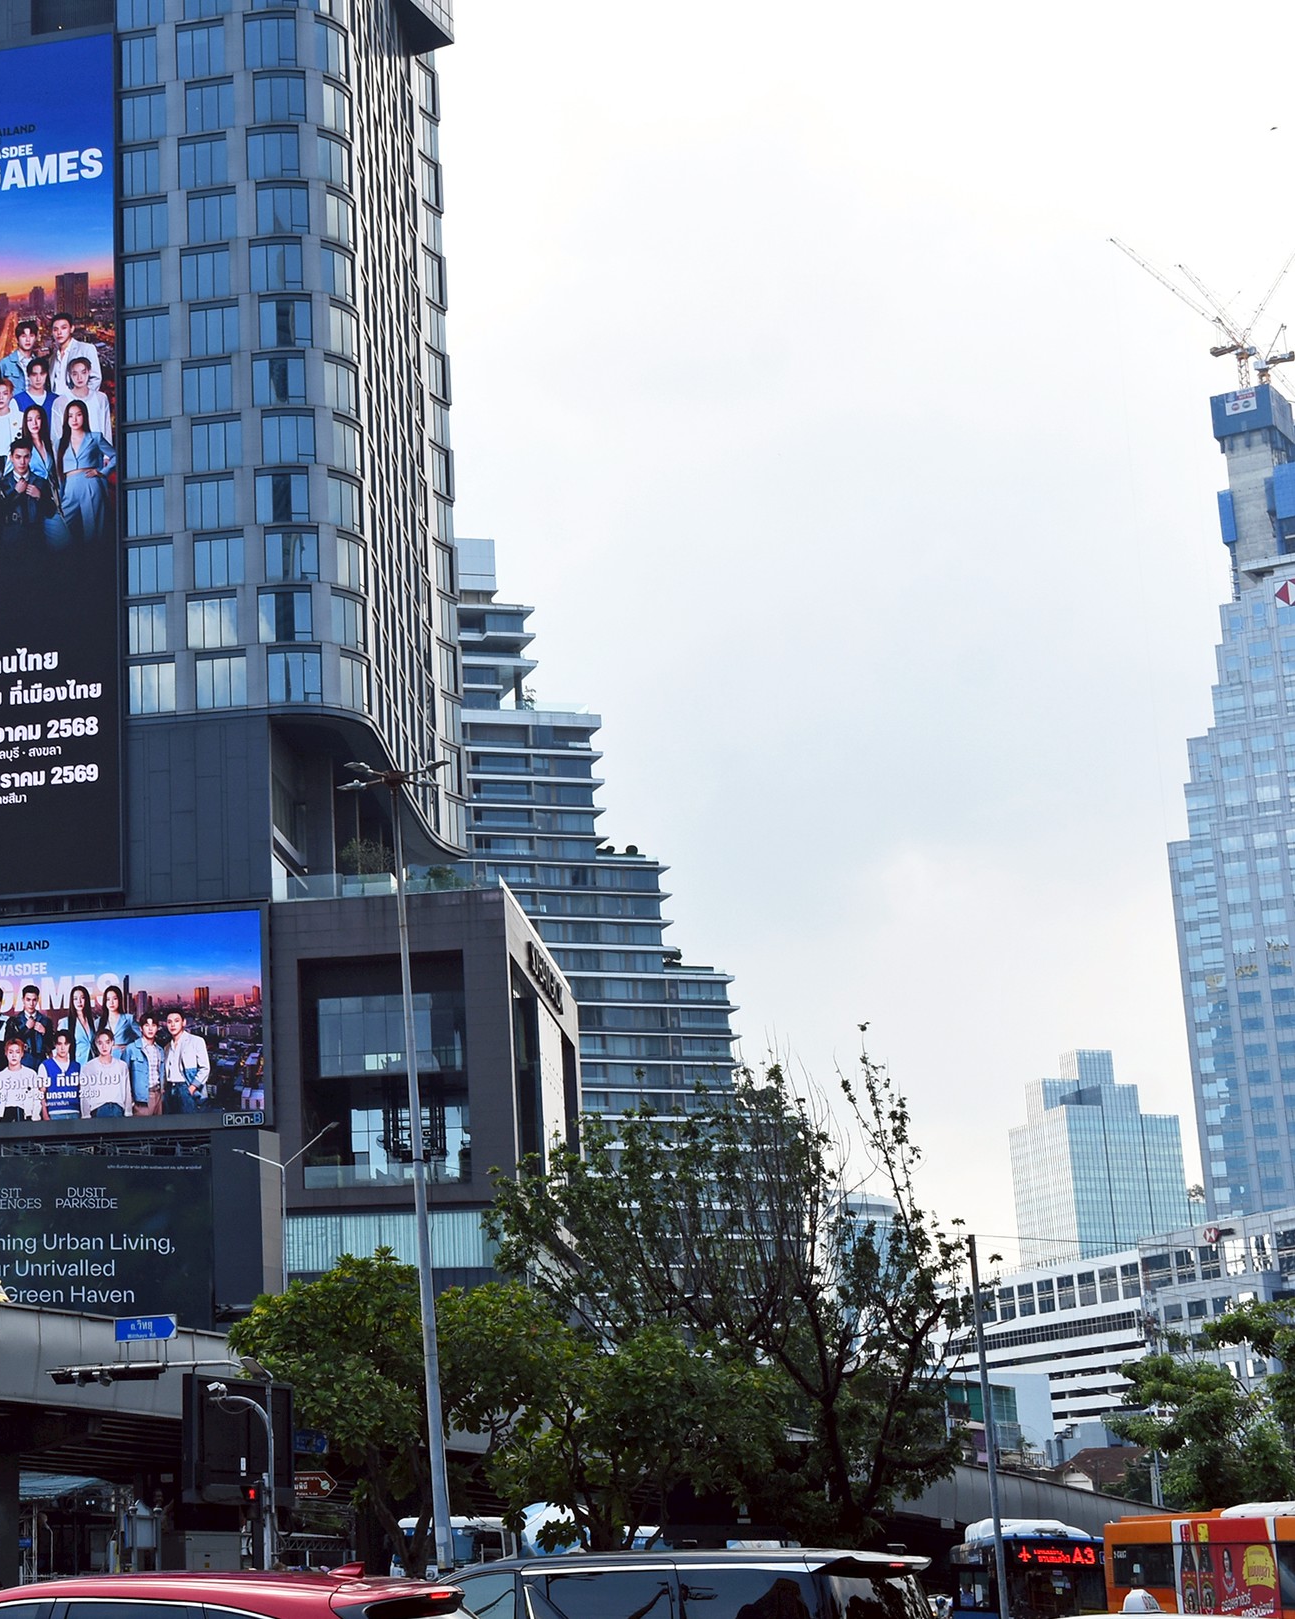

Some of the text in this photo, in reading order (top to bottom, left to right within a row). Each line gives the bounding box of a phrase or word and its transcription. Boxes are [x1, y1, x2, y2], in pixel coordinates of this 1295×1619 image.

[9, 679, 102, 706] ที่เมืองไทย
[46, 716, 99, 739] 2568
[28, 745, 62, 758] สงขลา
[51, 763, 99, 785] 2569
[67, 1187, 106, 1198] DUSIT
[55, 1197, 118, 1209] PARKSIDE
[43, 1233, 103, 1251] Urban
[110, 1233, 176, 1255] Living,
[15, 1259, 115, 1277] Unrivalled
[3, 1286, 135, 1304] Green Haven
[1072, 1546, 1095, 1565] A3
